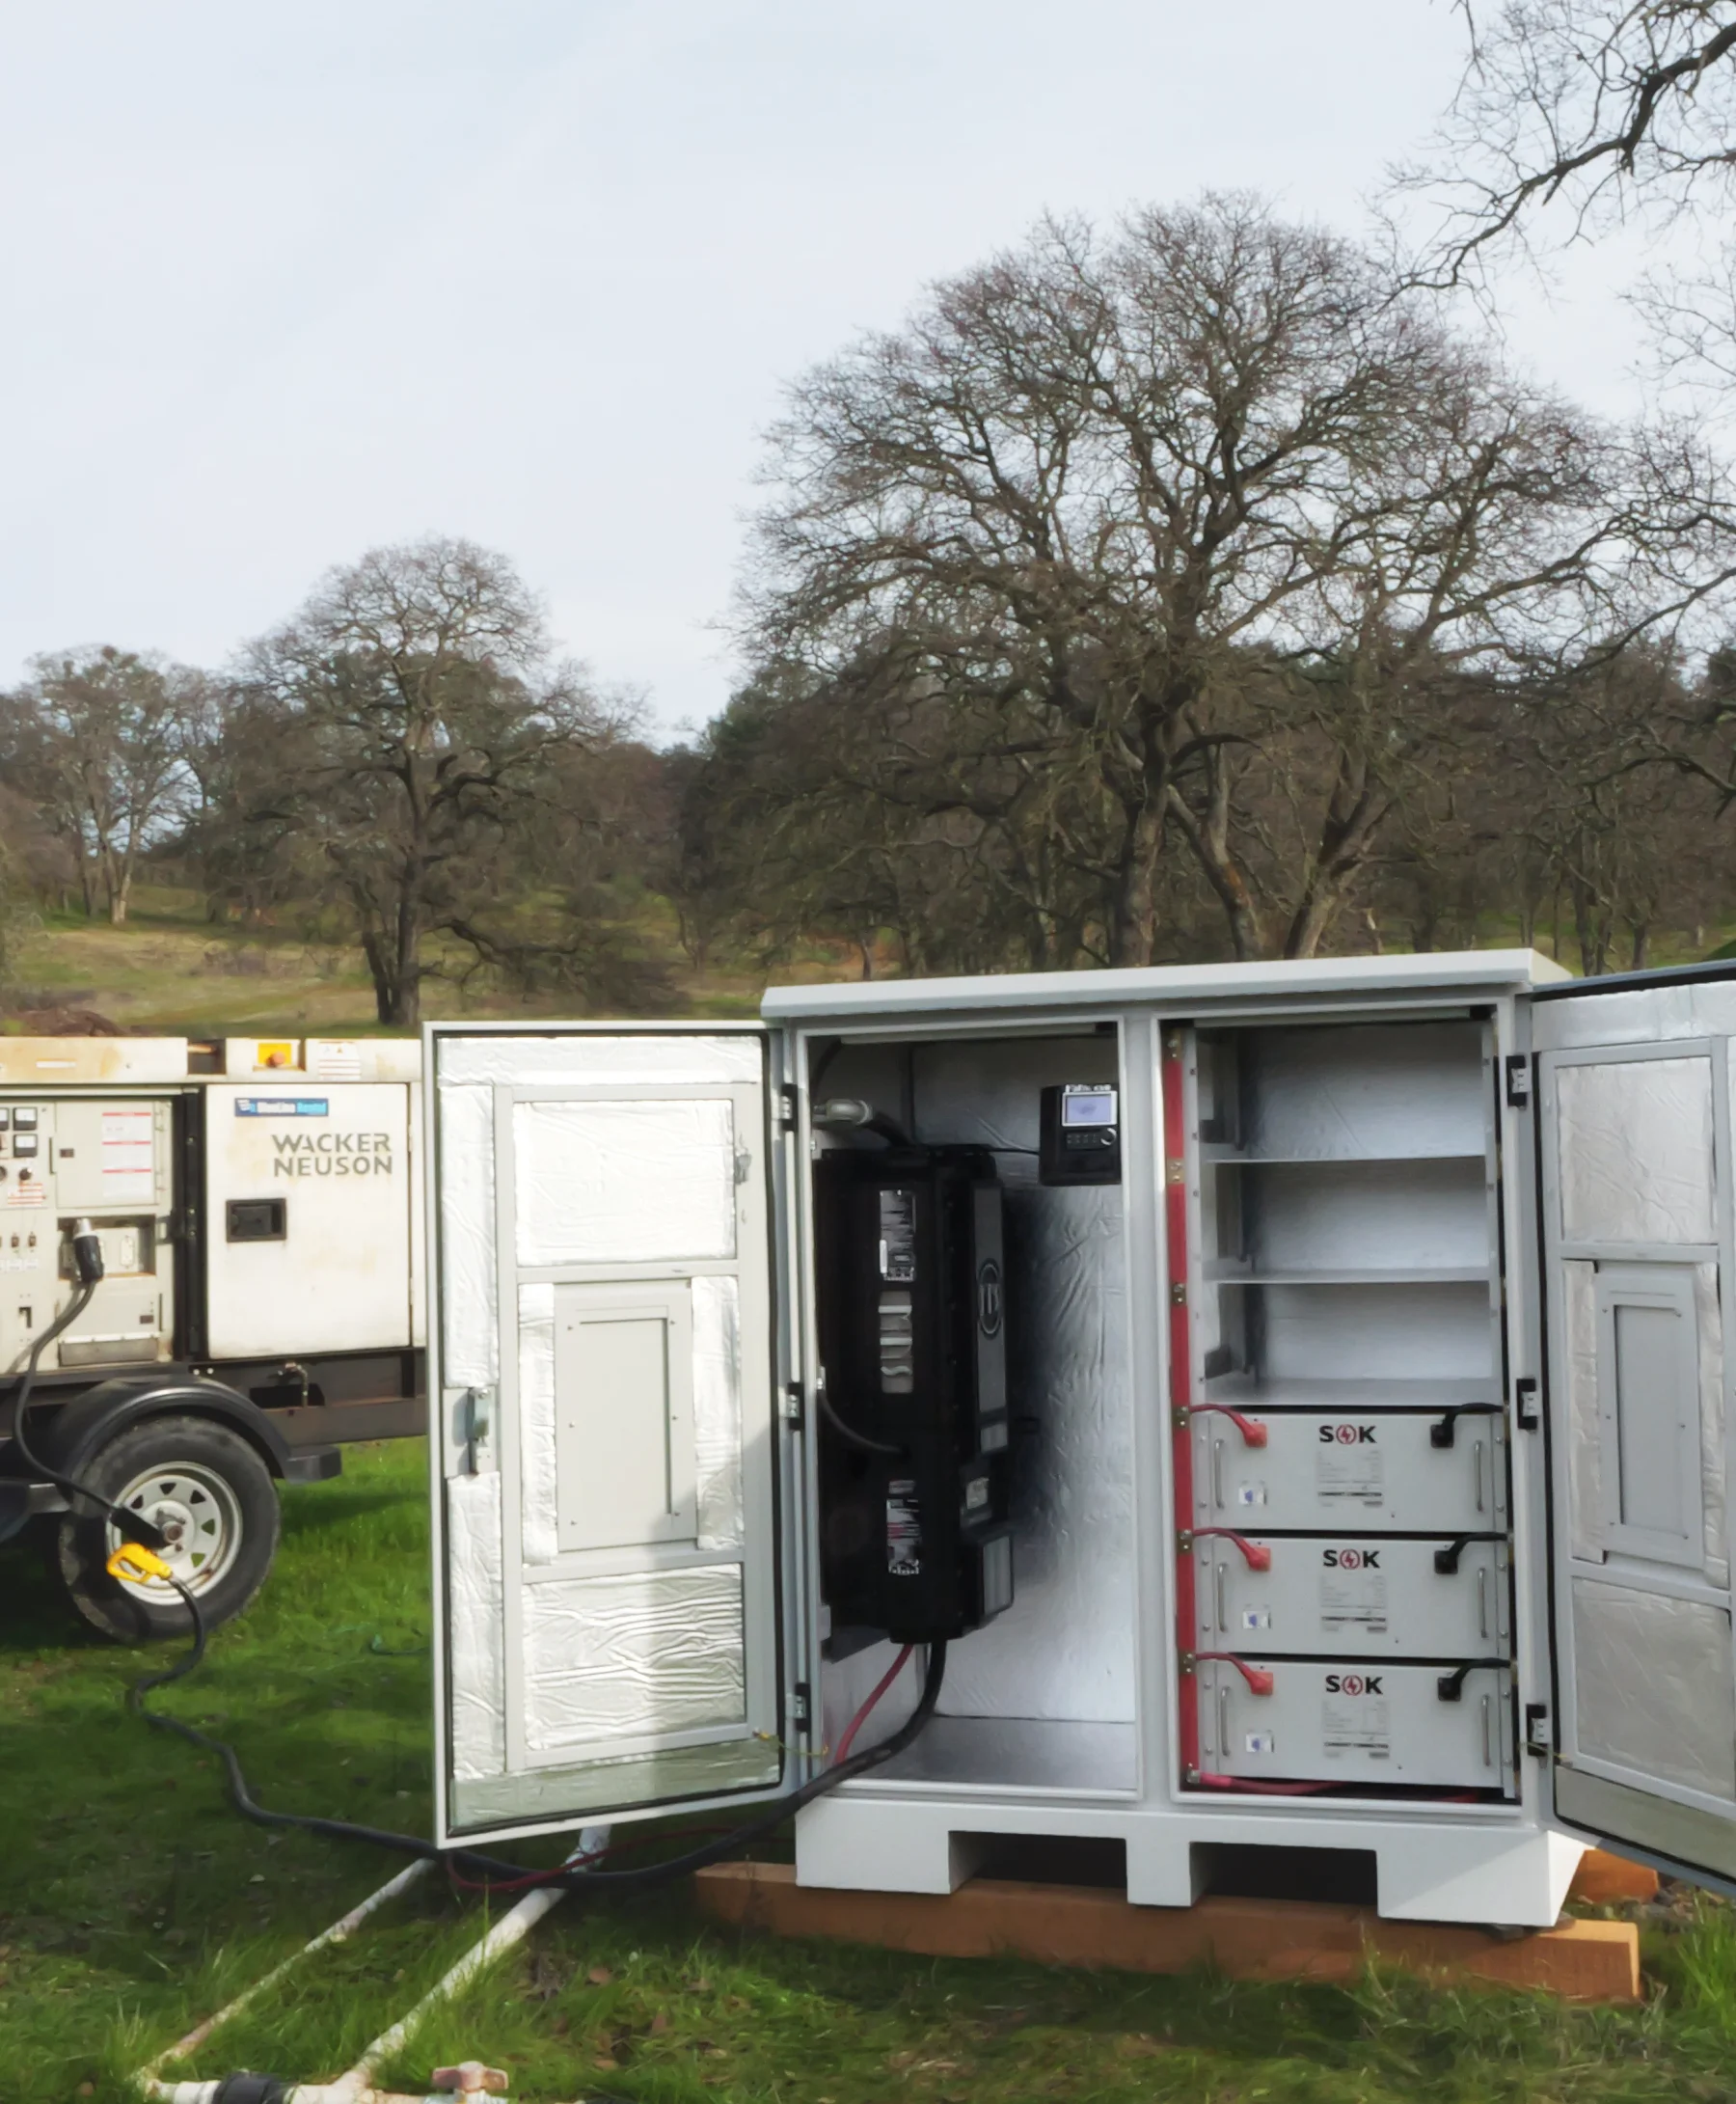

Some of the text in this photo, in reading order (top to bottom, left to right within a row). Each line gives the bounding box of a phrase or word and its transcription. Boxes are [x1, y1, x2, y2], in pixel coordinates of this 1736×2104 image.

[271, 1133, 392, 1154] WACKER
[273, 1156, 393, 1177] NEUSON
[1318, 1423, 1377, 1445] SOK
[1322, 1548, 1381, 1570] SOK
[1325, 1674, 1384, 1696] SOK
